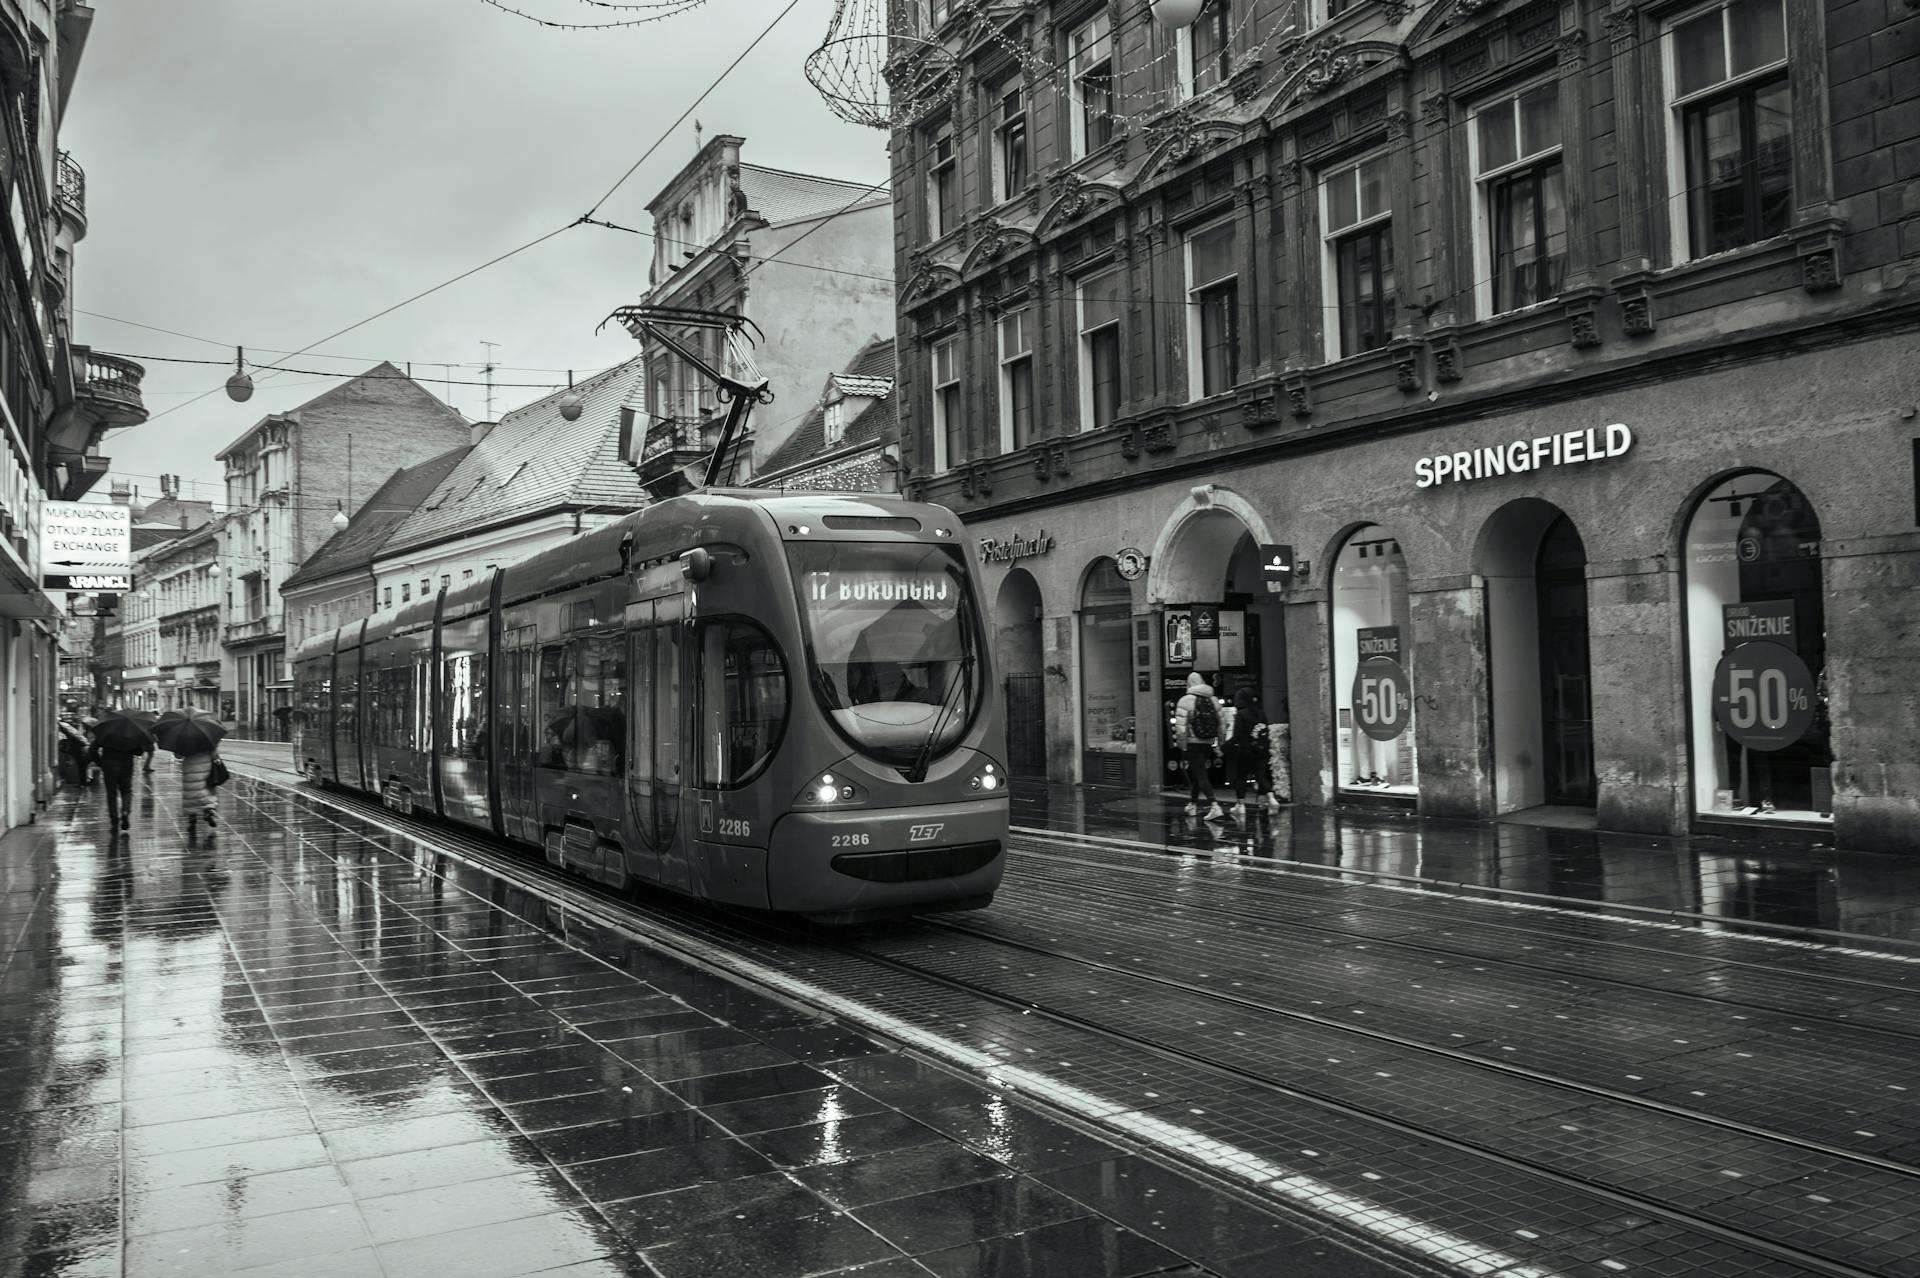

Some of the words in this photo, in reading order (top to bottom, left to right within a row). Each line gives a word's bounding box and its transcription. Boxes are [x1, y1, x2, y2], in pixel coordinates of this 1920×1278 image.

[1415, 423, 1632, 488] SPRINGFIELD
[47, 524, 87, 536] OTKUP
[91, 527, 125, 537] ZLATA
[53, 540, 119, 552] EXCHANGE
[811, 571, 830, 600] 17
[1727, 614, 1791, 638] SNIŽENJE
[1360, 636, 1398, 654] SNIŽENJE
[1356, 677, 1409, 725] -50%
[1720, 669, 1808, 729] -50%
[719, 818, 750, 837] 2286
[910, 823, 944, 842] ZET
[832, 833, 870, 848] 2286
